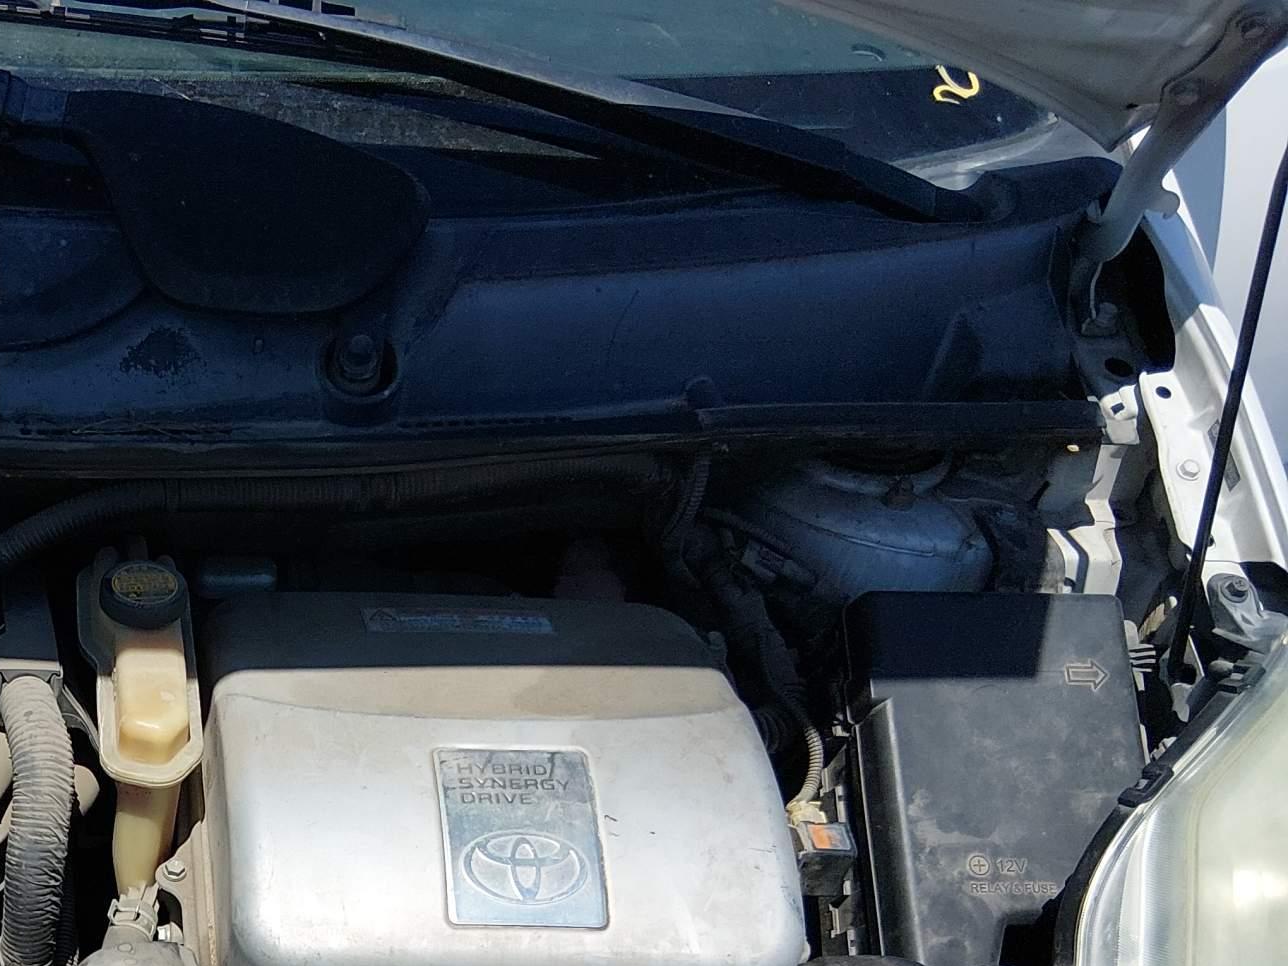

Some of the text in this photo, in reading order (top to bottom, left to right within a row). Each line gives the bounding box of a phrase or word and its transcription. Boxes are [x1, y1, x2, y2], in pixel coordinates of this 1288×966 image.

[457, 763, 548, 776] HYBRID
[459, 778, 570, 791] SYNERGY
[461, 792, 533, 805] DRIVE
[996, 858, 1027, 873] 12V
[970, 881, 1058, 895] RELAY & FUSE
